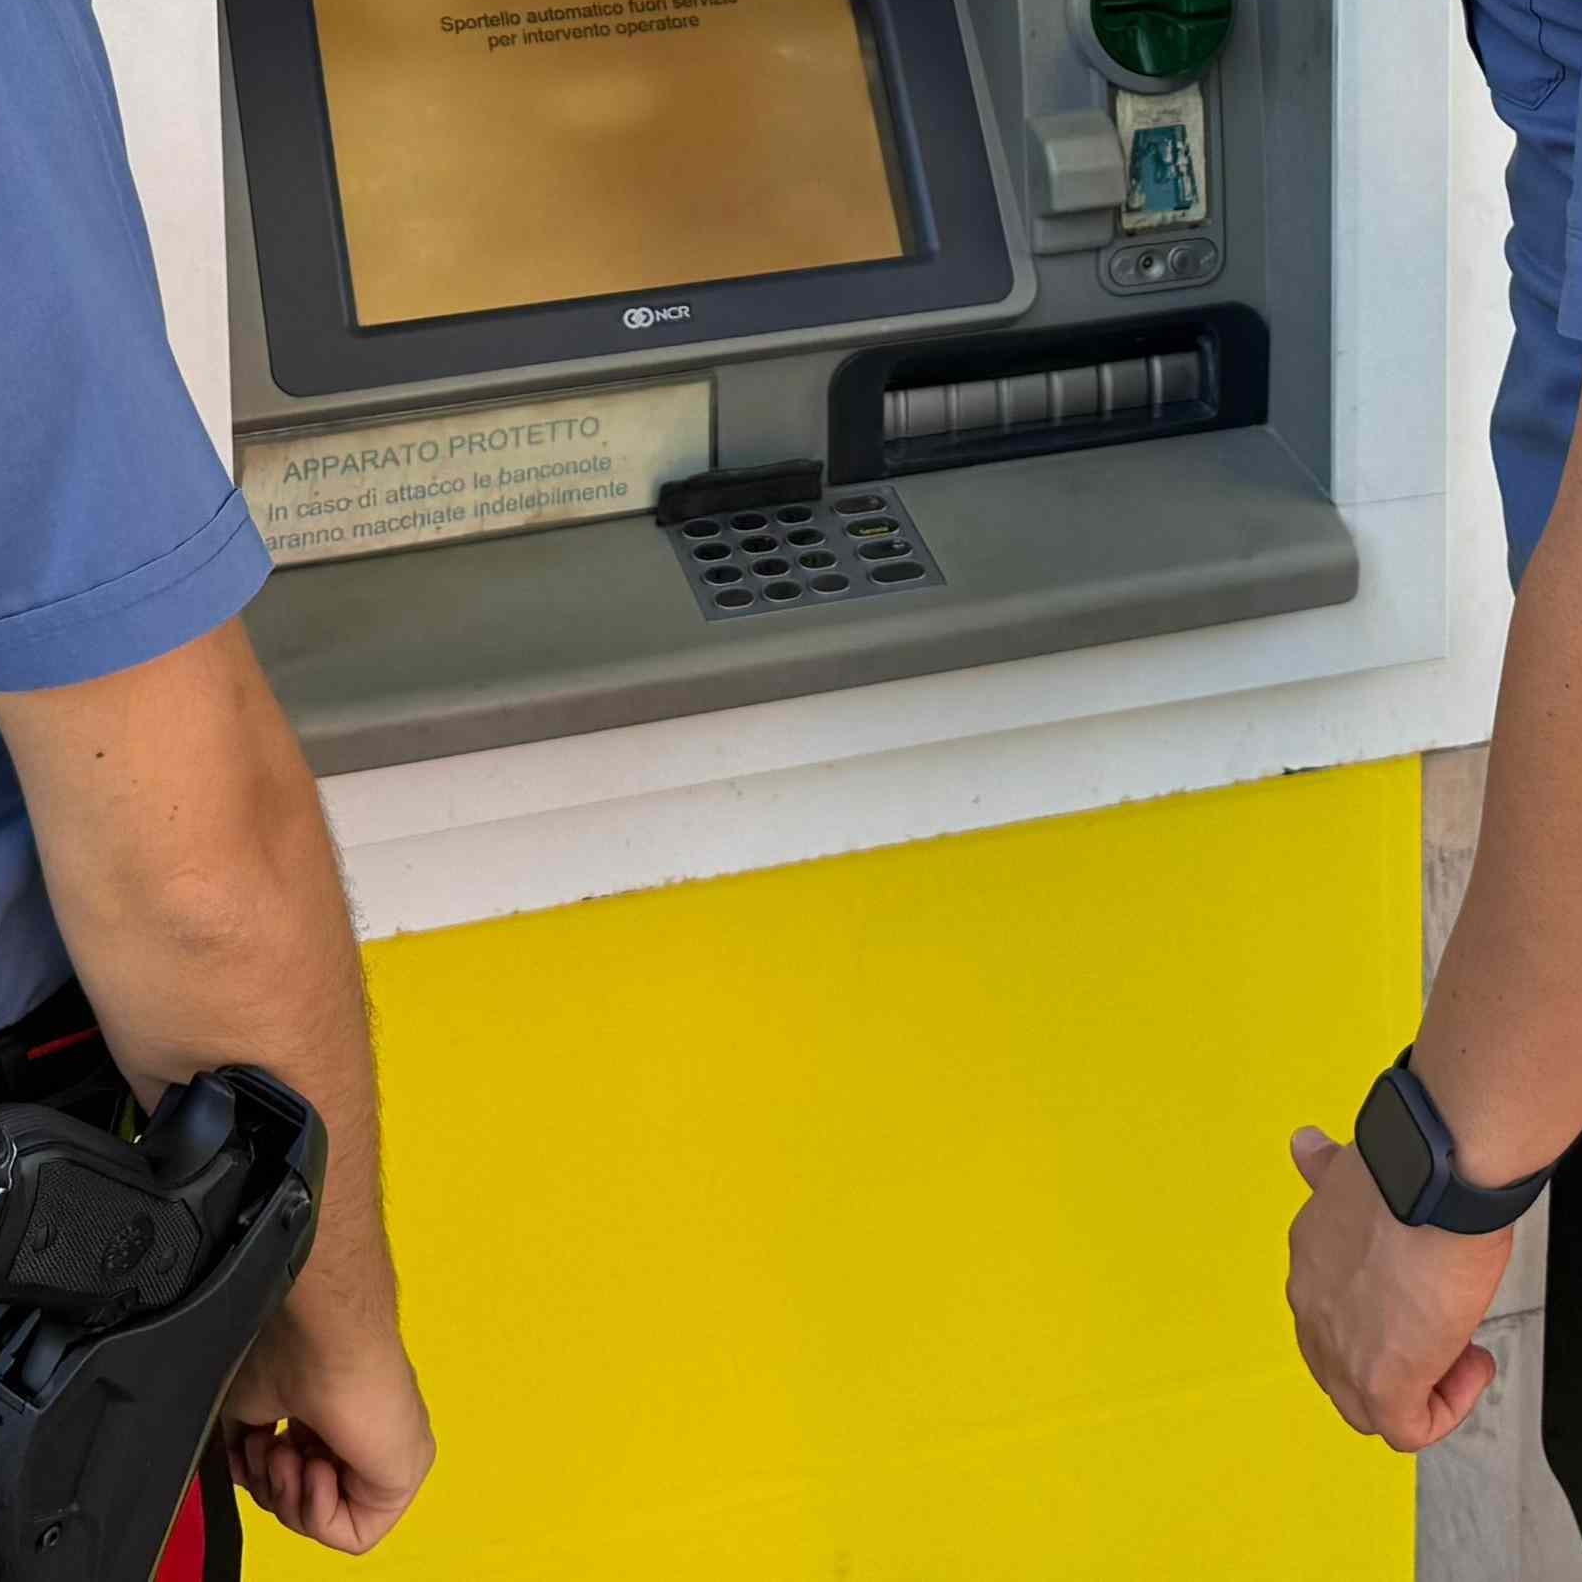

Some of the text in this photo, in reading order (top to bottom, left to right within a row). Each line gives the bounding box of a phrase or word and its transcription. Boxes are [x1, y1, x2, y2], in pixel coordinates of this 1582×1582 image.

[440, 11, 521, 34] Sportello
[526, 2, 623, 24] automatico
[488, 14, 700, 51] per intervento operatore
[655, 305, 691, 322] NCR
[283, 416, 601, 483] APPARATO PROTETTO
[268, 454, 612, 523] In caso di attacco le banconote
[265, 480, 628, 551] aranno macchiate indelebilmente
